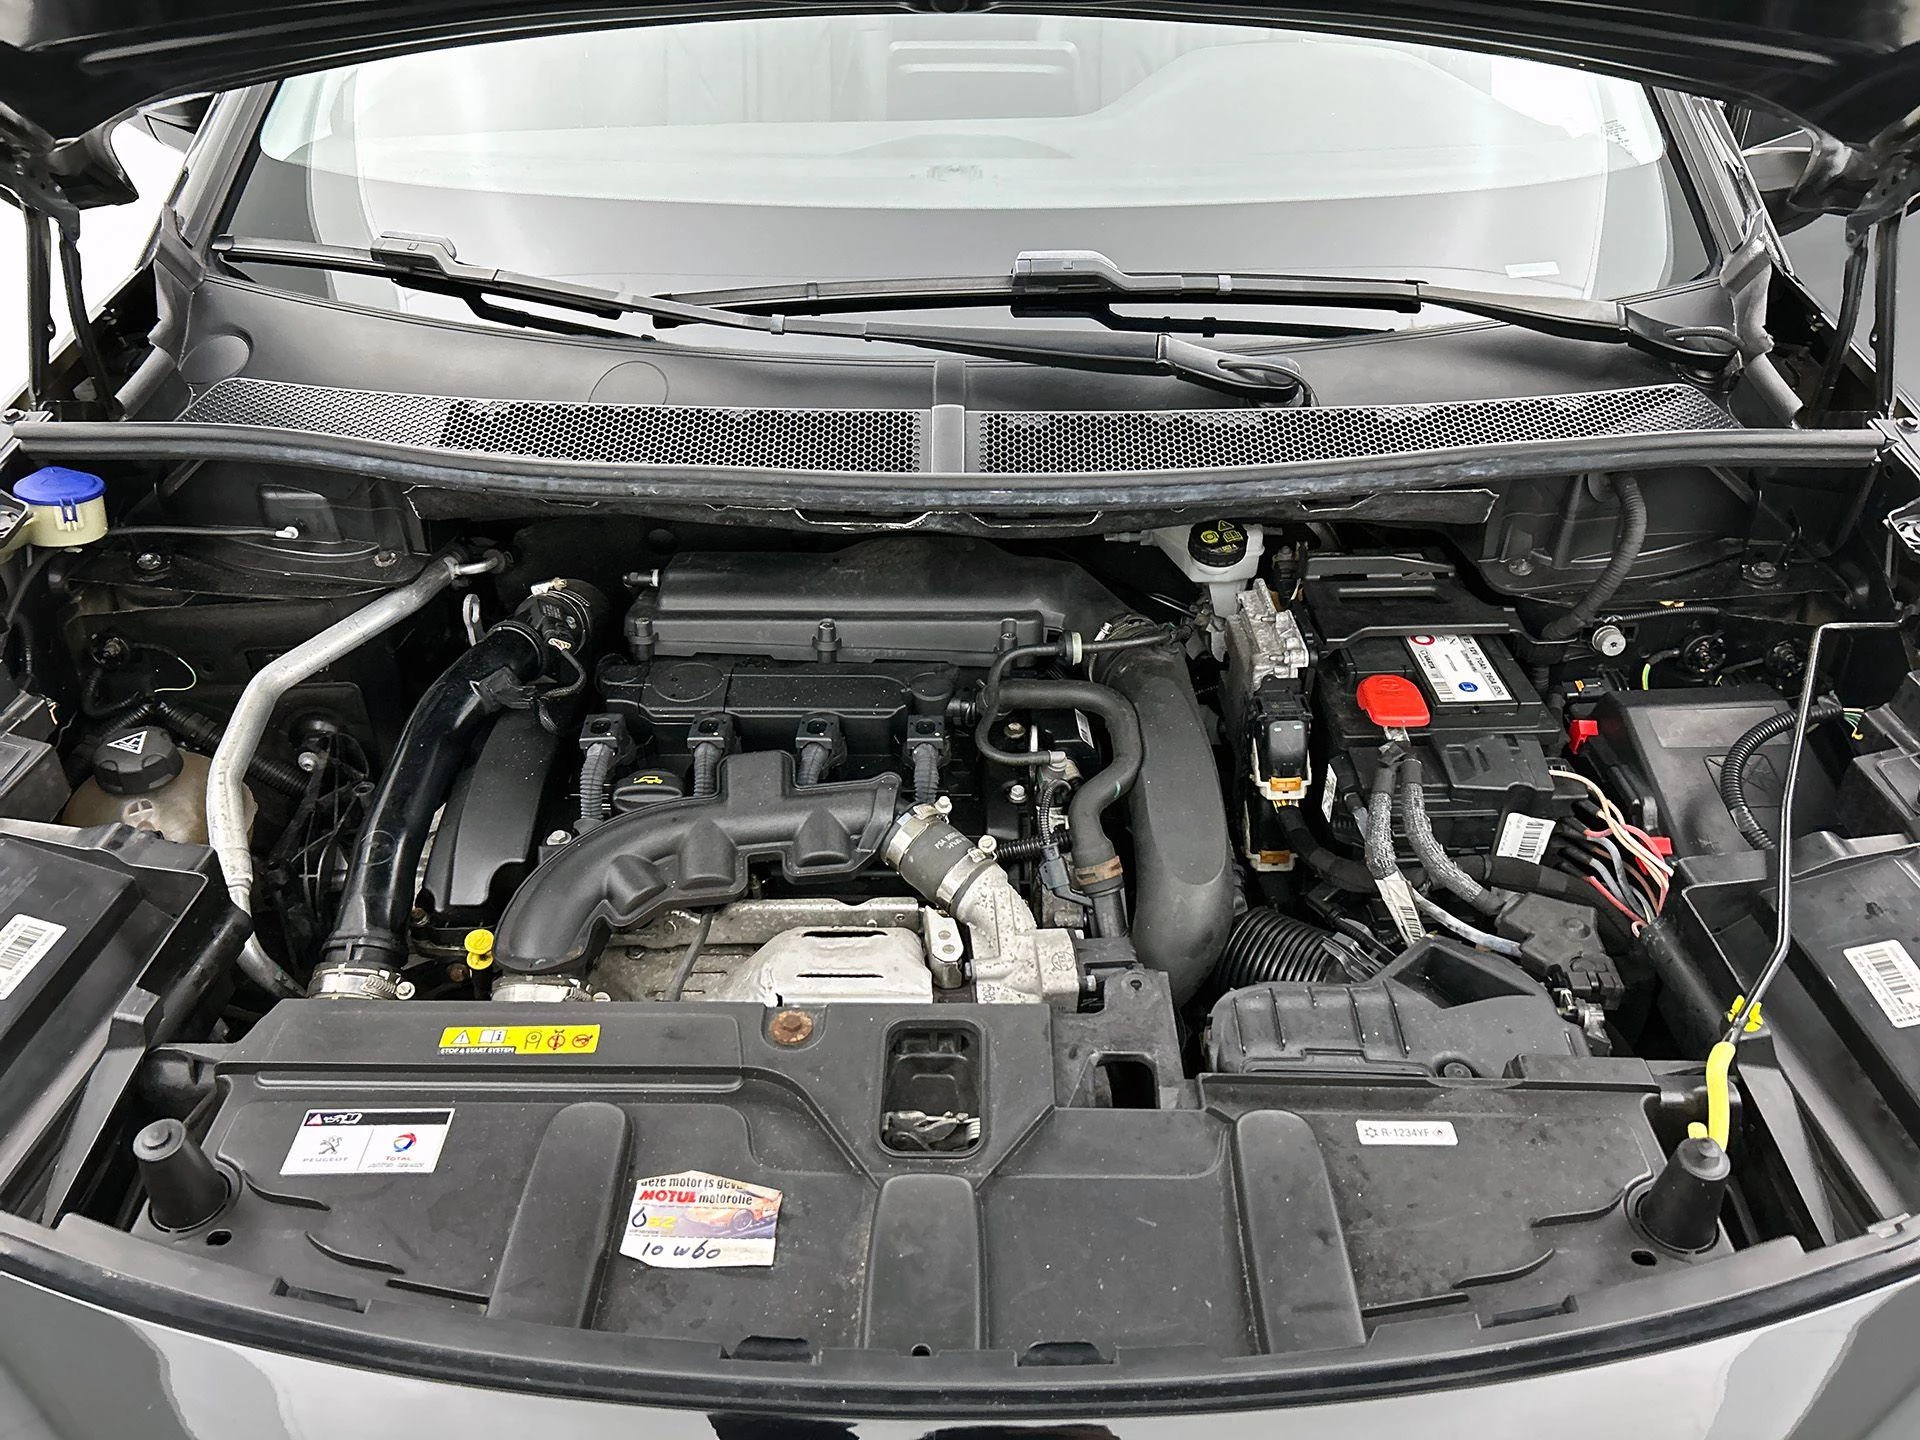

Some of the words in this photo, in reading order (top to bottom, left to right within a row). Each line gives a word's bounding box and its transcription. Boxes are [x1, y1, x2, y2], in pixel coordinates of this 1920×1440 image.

[440, 1047, 459, 1055] STOP
[487, 1046, 515, 1054] SYSTEM
[668, 1177, 702, 1188] motor
[639, 1189, 697, 1203] MOTUL
[698, 1194, 753, 1206] motorolie
[641, 1241, 664, 1257] 10
